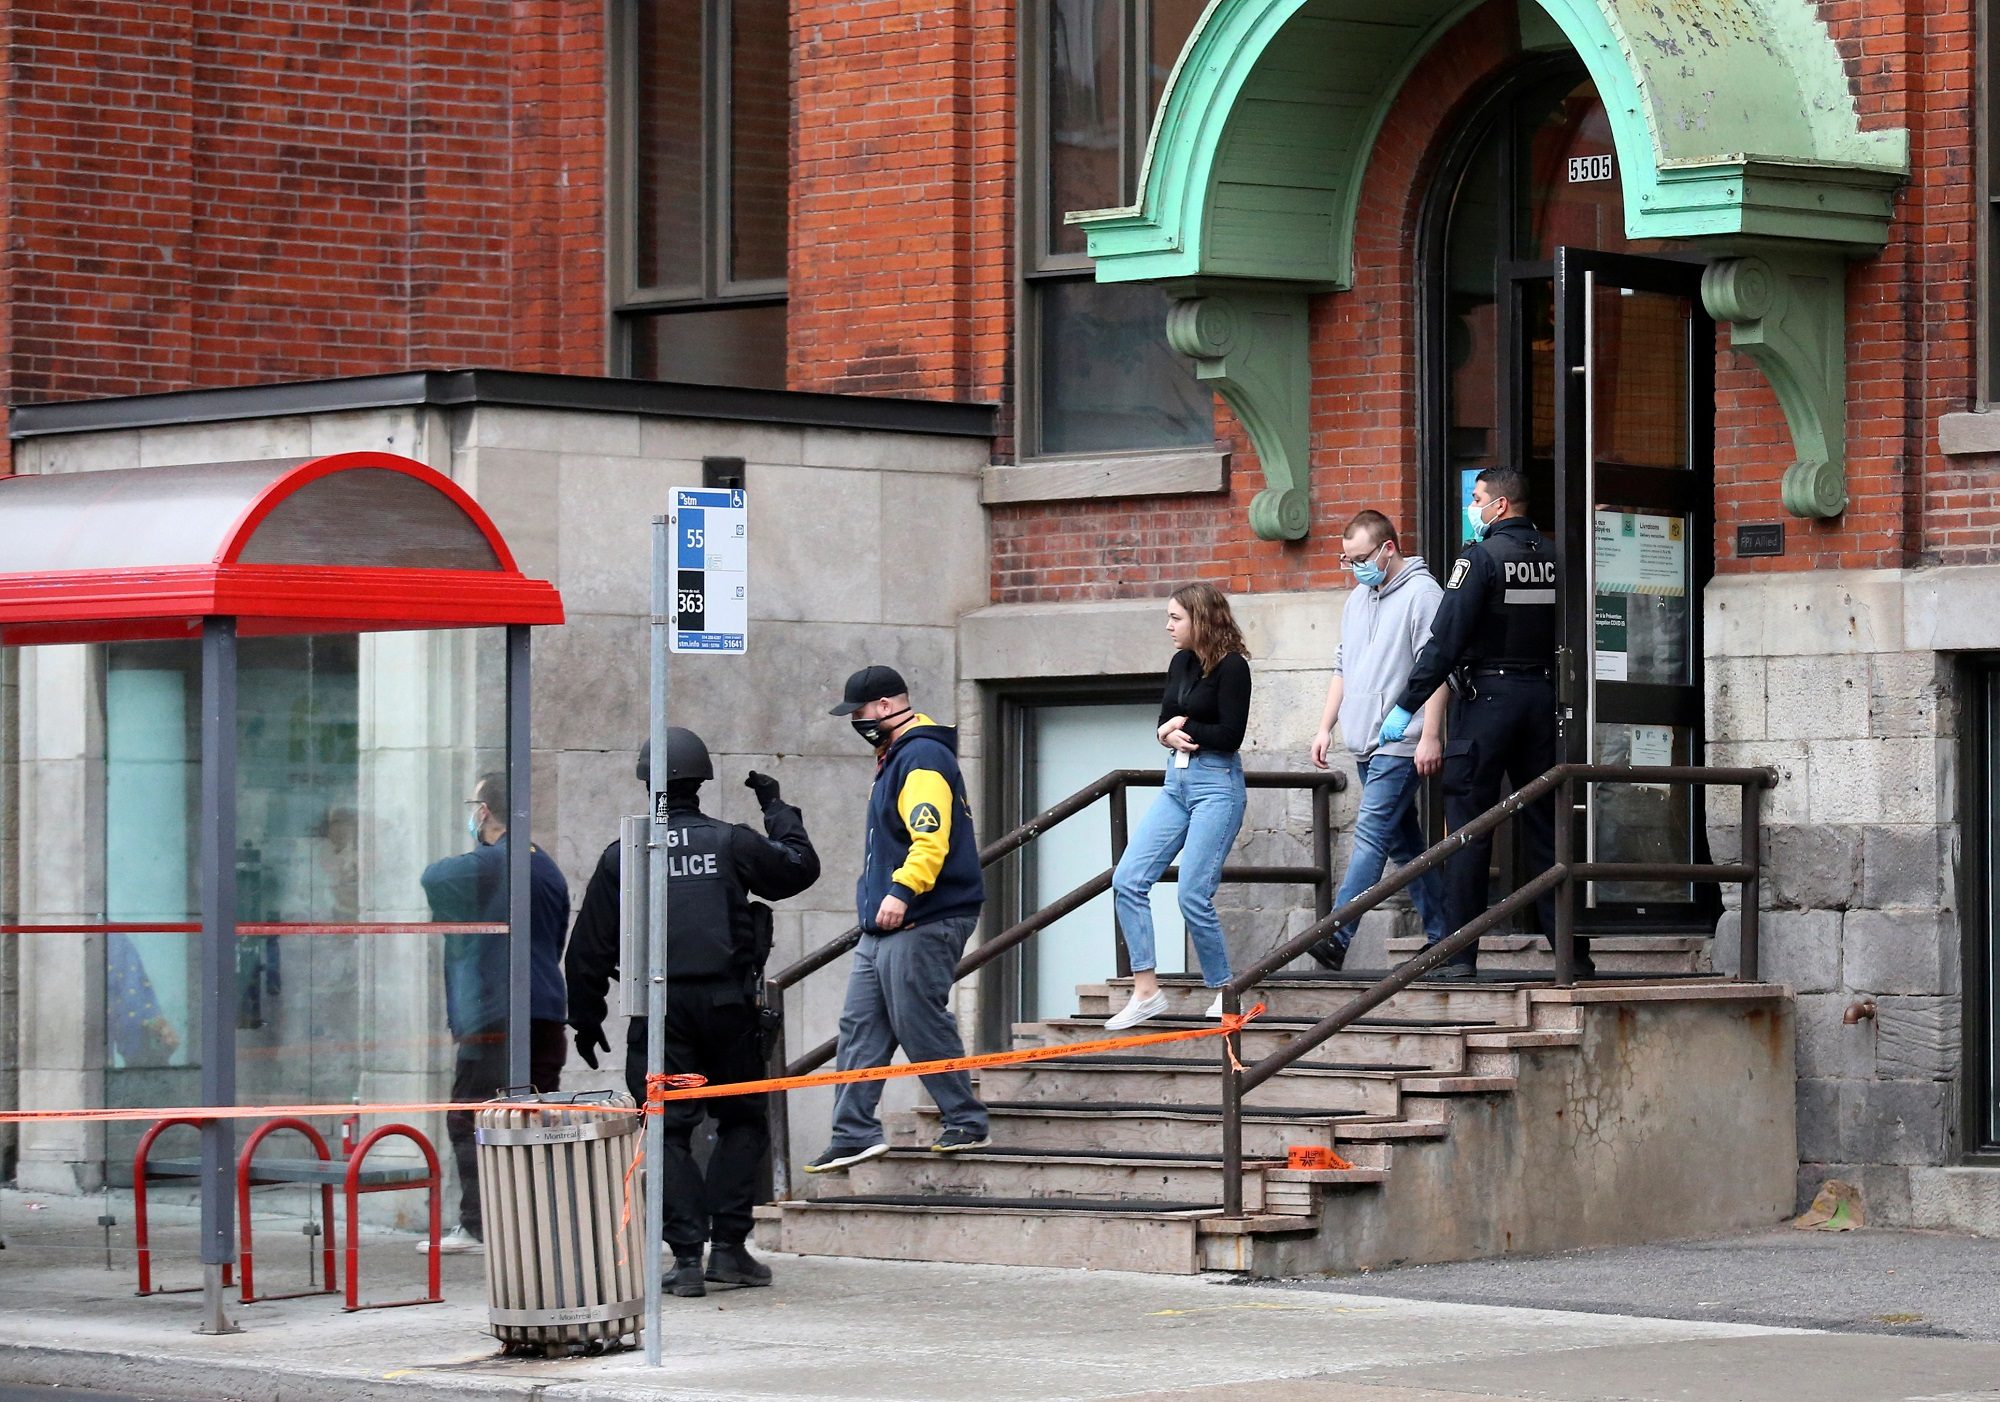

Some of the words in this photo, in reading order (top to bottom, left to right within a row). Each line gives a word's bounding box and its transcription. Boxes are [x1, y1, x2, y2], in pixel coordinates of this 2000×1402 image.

[1571, 157, 1609, 180] 5505
[683, 496, 697, 506] stm
[687, 529, 704, 549] 55
[1504, 562, 1556, 583] POLIC
[678, 593, 704, 614] 363
[679, 640, 700, 648] stm.info
[724, 640, 742, 648] 51641
